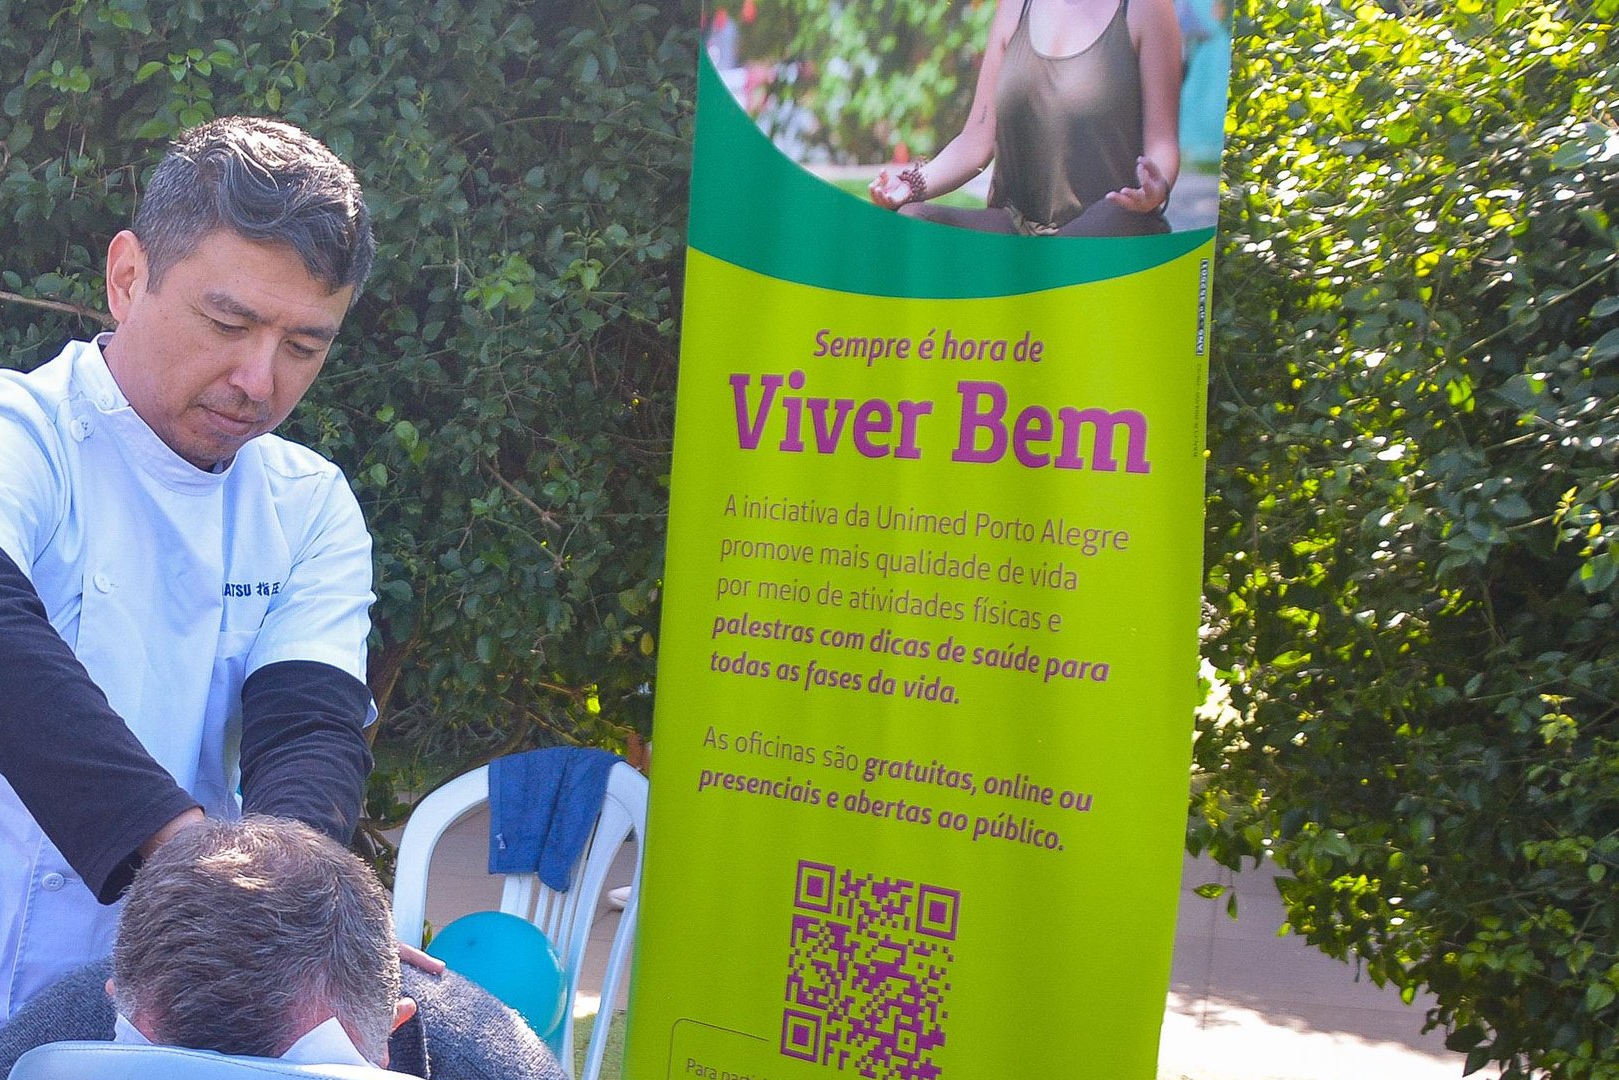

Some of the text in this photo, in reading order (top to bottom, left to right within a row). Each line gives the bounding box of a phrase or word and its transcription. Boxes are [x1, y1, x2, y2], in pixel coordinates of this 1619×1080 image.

[812, 327, 1044, 367] Sempre é hora de
[1196, 328, 1205, 352] ANS
[729, 369, 934, 460] Viver
[951, 379, 1152, 474] Bem
[723, 495, 1130, 557] A iniciativa da Unimed Porto Alegre
[719, 536, 1078, 591] promove mais qualidade de vida
[716, 576, 1062, 634] por meio de atividades físicas e
[710, 649, 960, 705] todas as fases da vida.
[711, 612, 1110, 682] palestras com dicas de saúde para
[703, 725, 1093, 813] As oficinas são gratuitas, online ou
[697, 766, 1065, 851] presenciais e abertas ao público.
